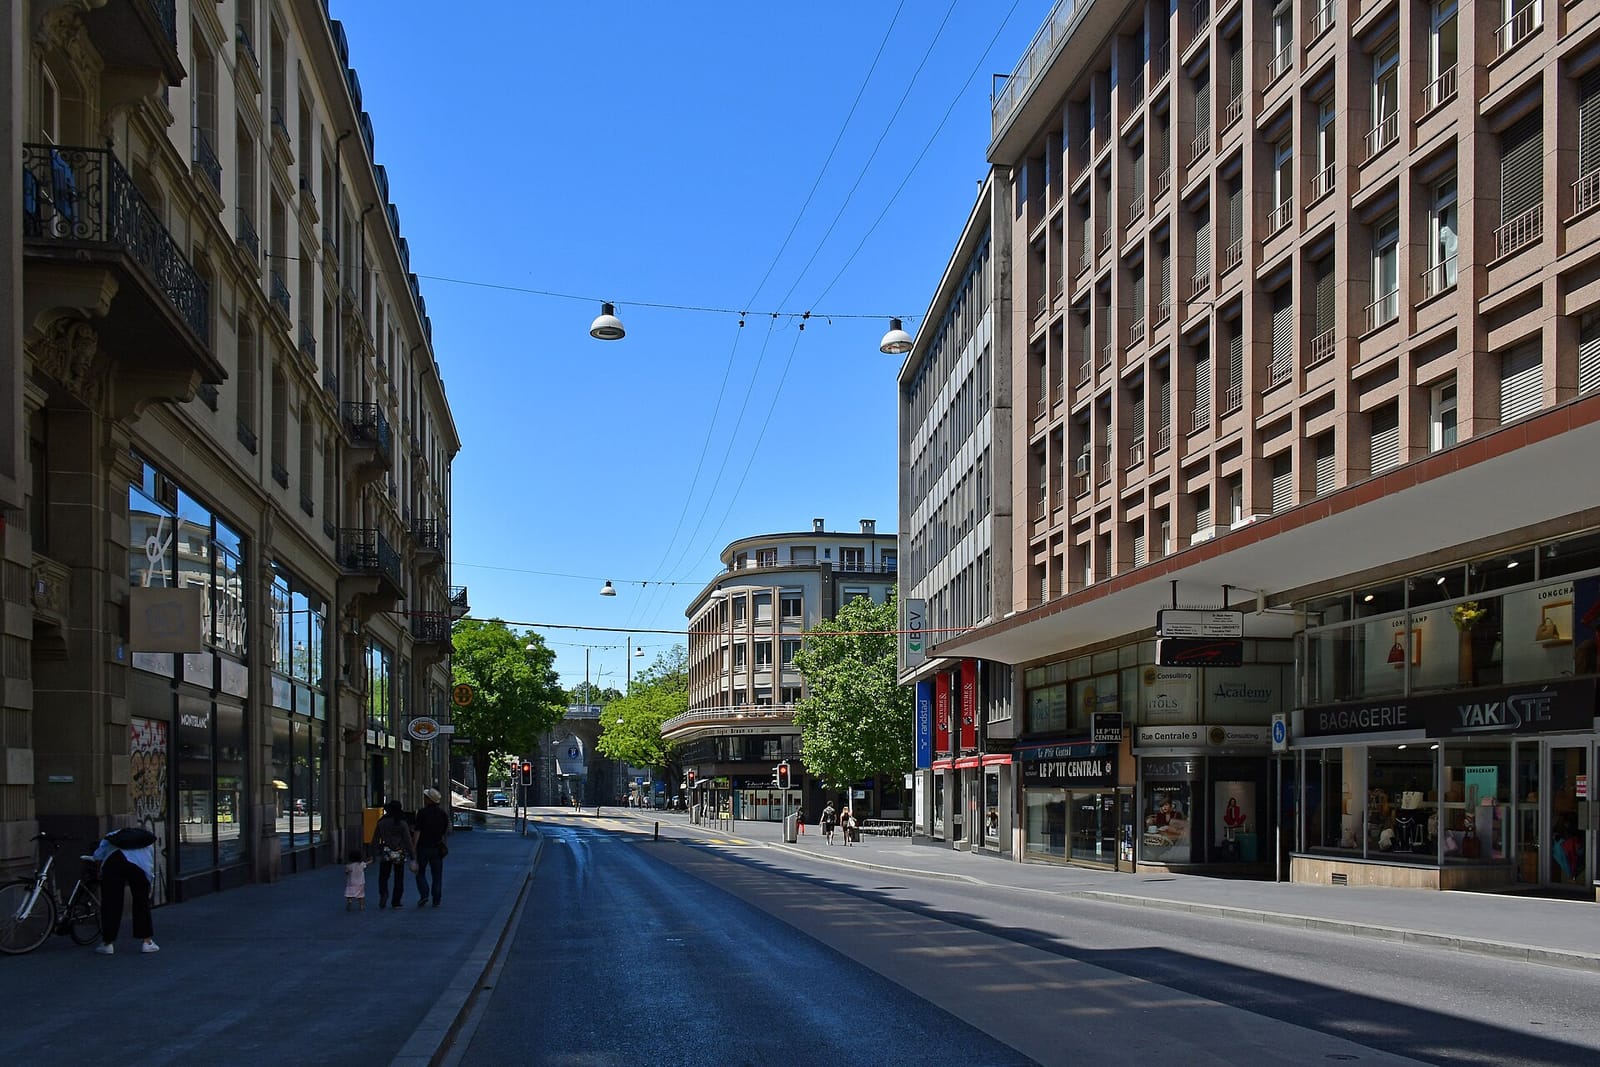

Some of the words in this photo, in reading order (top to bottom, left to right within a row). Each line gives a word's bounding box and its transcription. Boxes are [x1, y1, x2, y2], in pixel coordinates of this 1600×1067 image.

[910, 611, 921, 639] BCV
[1157, 672, 1192, 680] Consulting
[1214, 683, 1272, 702] Academy
[920, 700, 928, 735] randstad
[1319, 705, 1408, 731] BAGAGERIE
[1155, 731, 1190, 740] Centrale
[1192, 731, 1198, 740] 9
[1040, 763, 1047, 778] LE
[1048, 762, 1066, 777] P'TIT
[1067, 760, 1102, 777] CENTRAL
